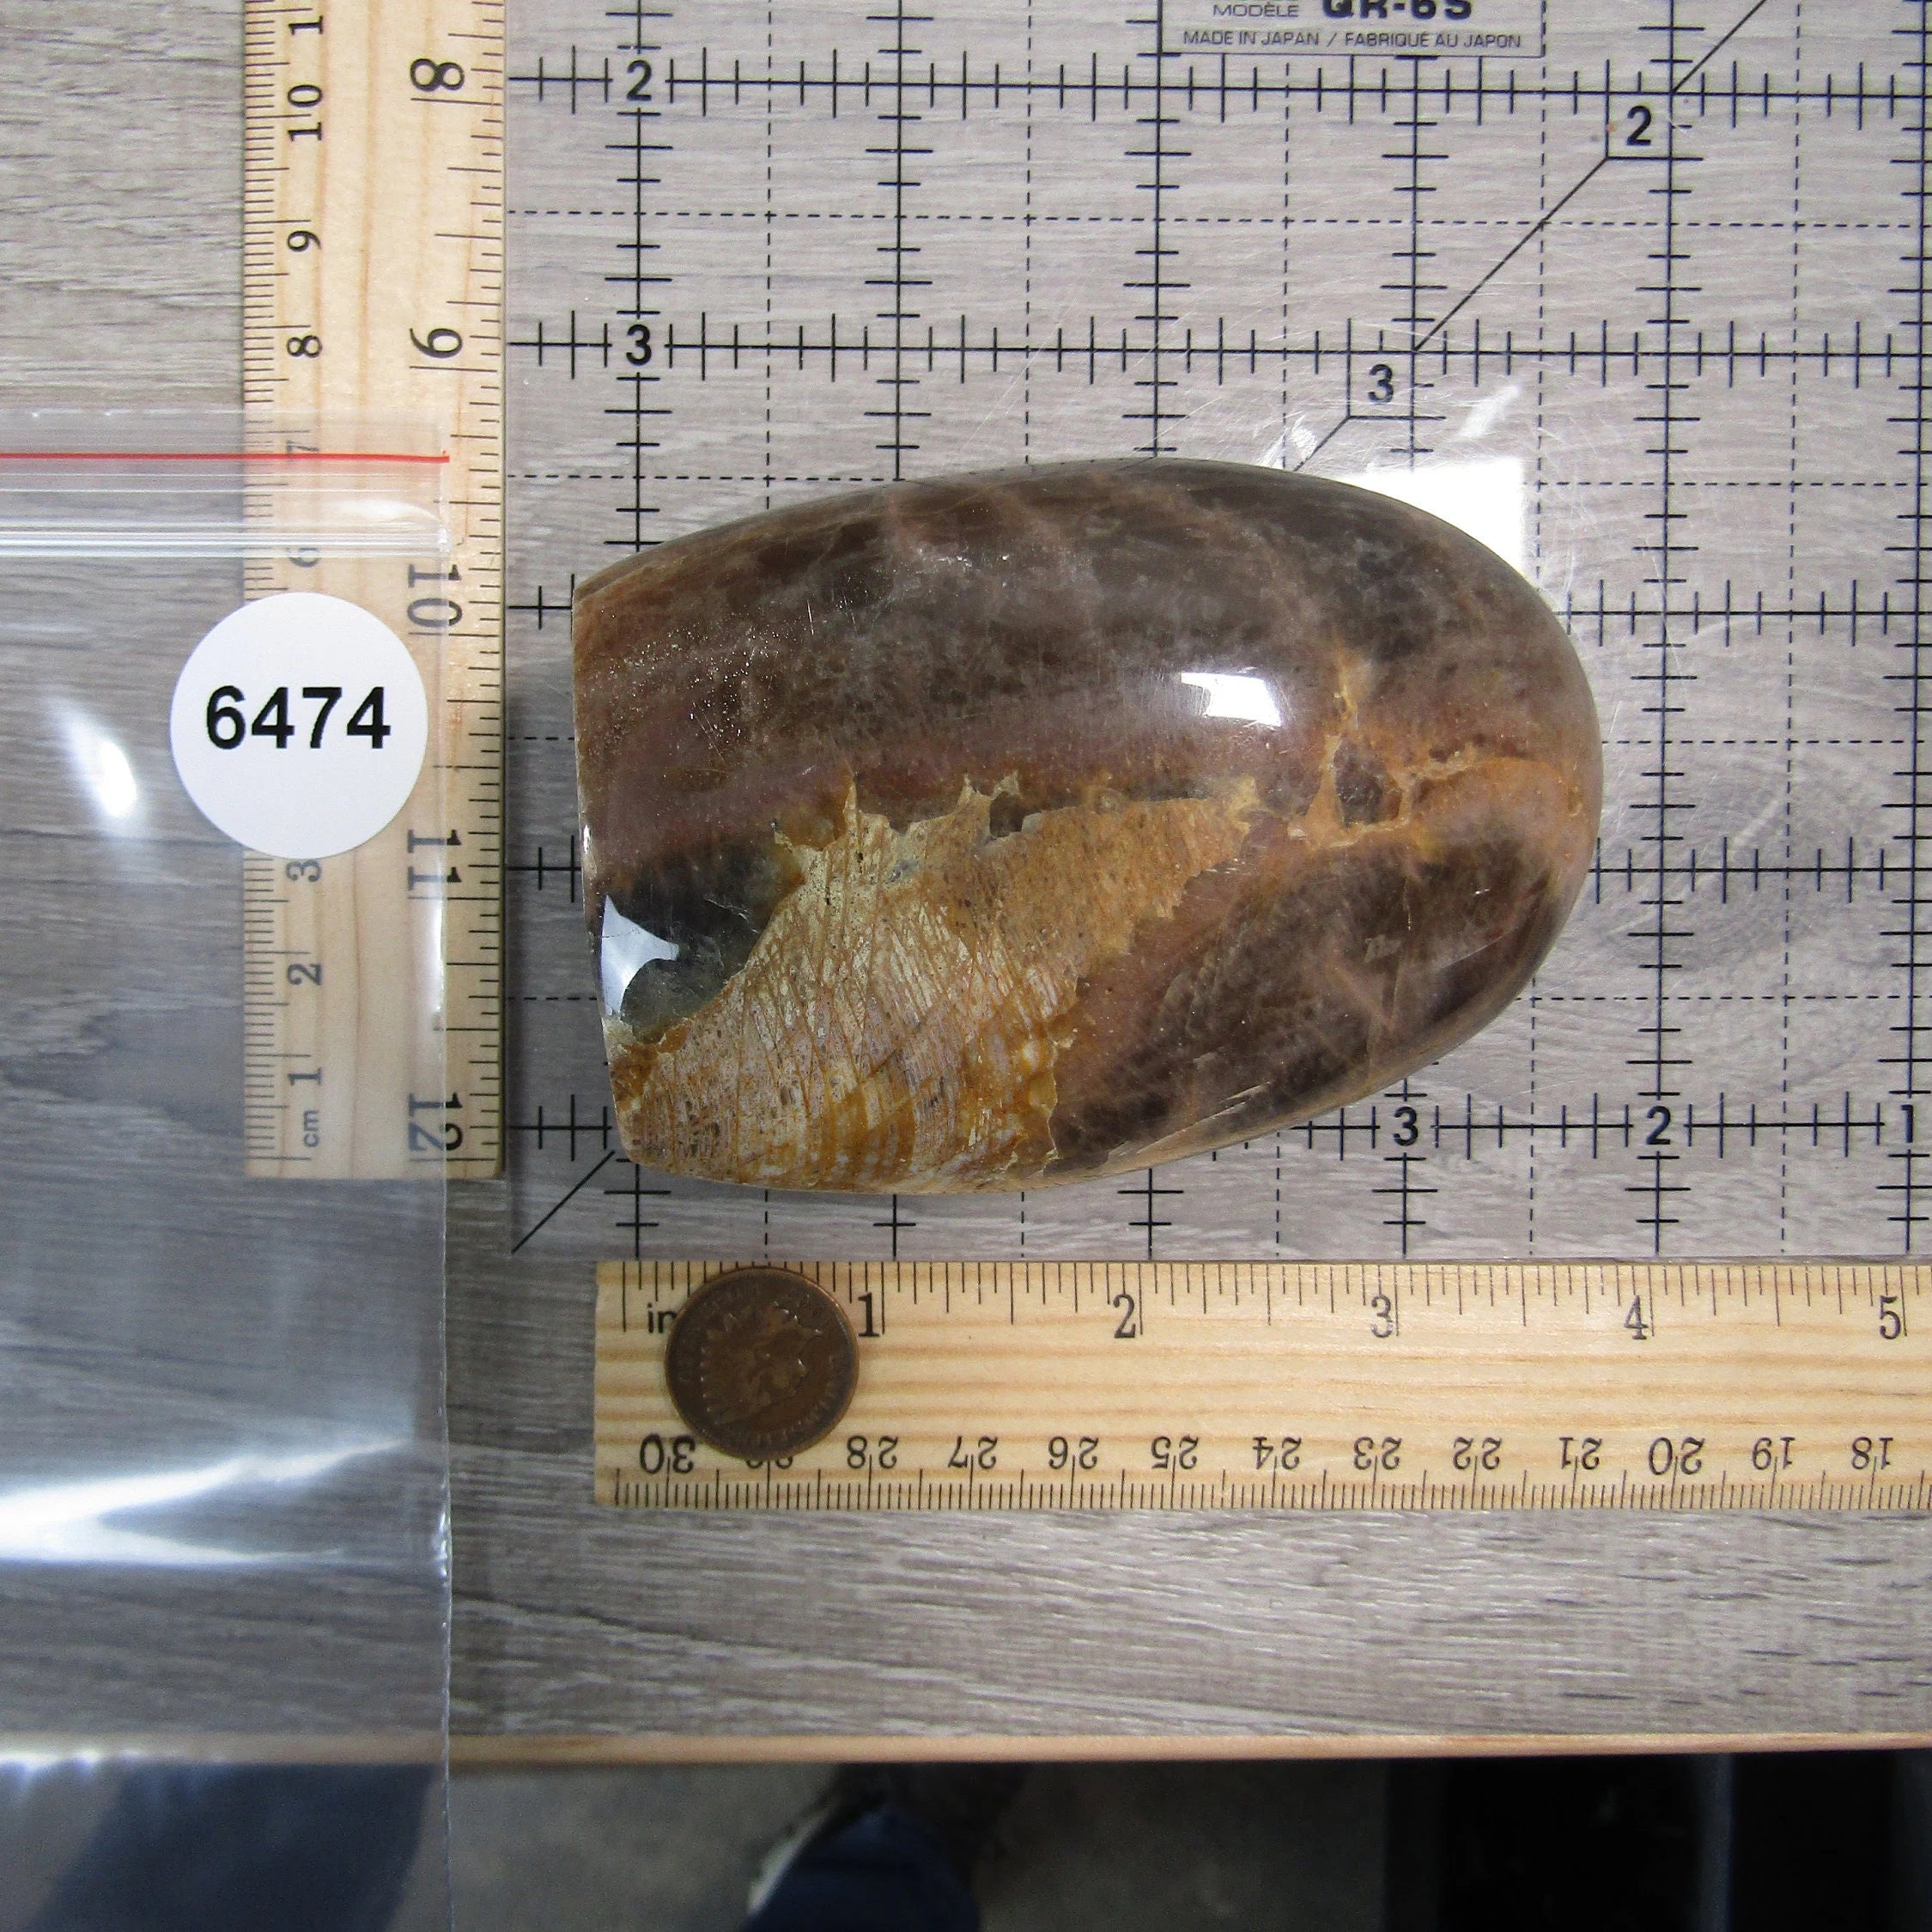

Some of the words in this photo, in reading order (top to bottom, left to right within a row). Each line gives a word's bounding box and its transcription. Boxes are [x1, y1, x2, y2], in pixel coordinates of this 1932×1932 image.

[1214, 2, 1299, 17] MODÈLE
[1184, 30, 1233, 45] MADE
[1239, 32, 1257, 45] IN
[1261, 32, 1319, 46] JAPAN
[1435, 33, 1458, 47] AU
[1464, 34, 1520, 48] JAPON
[410, 58, 465, 92] 8
[626, 60, 652, 101] 2
[288, 85, 323, 141] 10
[1627, 106, 1651, 146] 2
[288, 231, 320, 252] 9
[287, 335, 322, 357] 8
[410, 328, 462, 358] 9
[626, 324, 652, 366] 3
[1369, 364, 1394, 402] 3
[407, 564, 462, 628] 10
[207, 685, 391, 750] 6474
[286, 860, 321, 882] 3
[407, 829, 462, 890] 11
[287, 963, 322, 986] 2
[287, 1068, 322, 1085] 1
[302, 1110, 320, 1147] cm
[410, 1092, 463, 1151] 12
[1394, 1107, 1419, 1146] 3
[1647, 1106, 1671, 1145] 2
[1901, 1104, 1914, 1143] 1
[857, 1293, 880, 1338] 1
[1114, 1294, 1137, 1339] 2
[1371, 1295, 1392, 1339] 3
[1625, 1297, 1648, 1340] 4
[1880, 1297, 1901, 1340] 5
[640, 1434, 696, 1474] 30
[847, 1435, 898, 1469] 28
[948, 1436, 998, 1469] 27
[1048, 1437, 1098, 1469] 26
[1151, 1435, 1199, 1469] 25
[1253, 1437, 1302, 1469] 24
[1354, 1437, 1401, 1469] 23
[1453, 1437, 1501, 1469] 22
[1559, 1437, 1601, 1469] 21
[1649, 1437, 1704, 1475] 20
[1753, 1437, 1795, 1469] 19
[1852, 1437, 1893, 1469] 18
